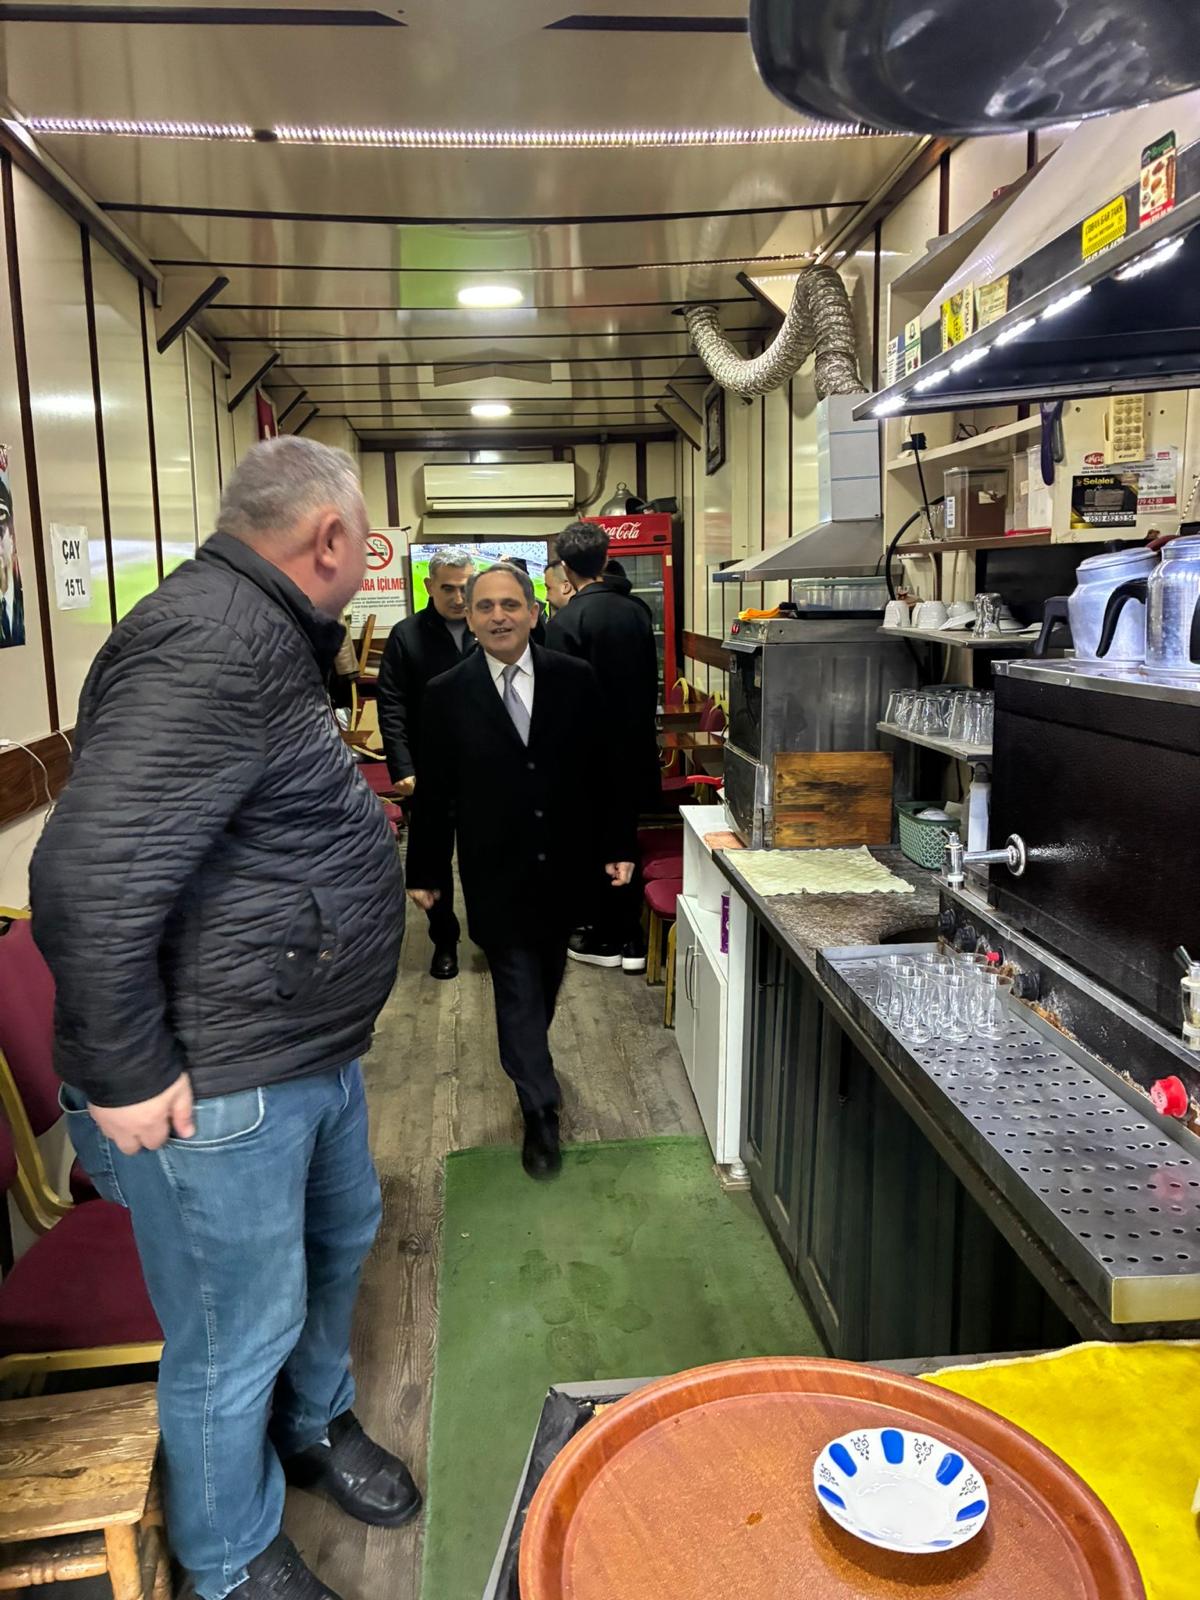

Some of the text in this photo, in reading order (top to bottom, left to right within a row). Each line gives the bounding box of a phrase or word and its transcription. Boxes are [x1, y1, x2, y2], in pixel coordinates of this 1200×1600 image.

[62, 540, 80, 565] ÇAY
[65, 578, 86, 597] 15 TL
[360, 577, 376, 592] ARA
